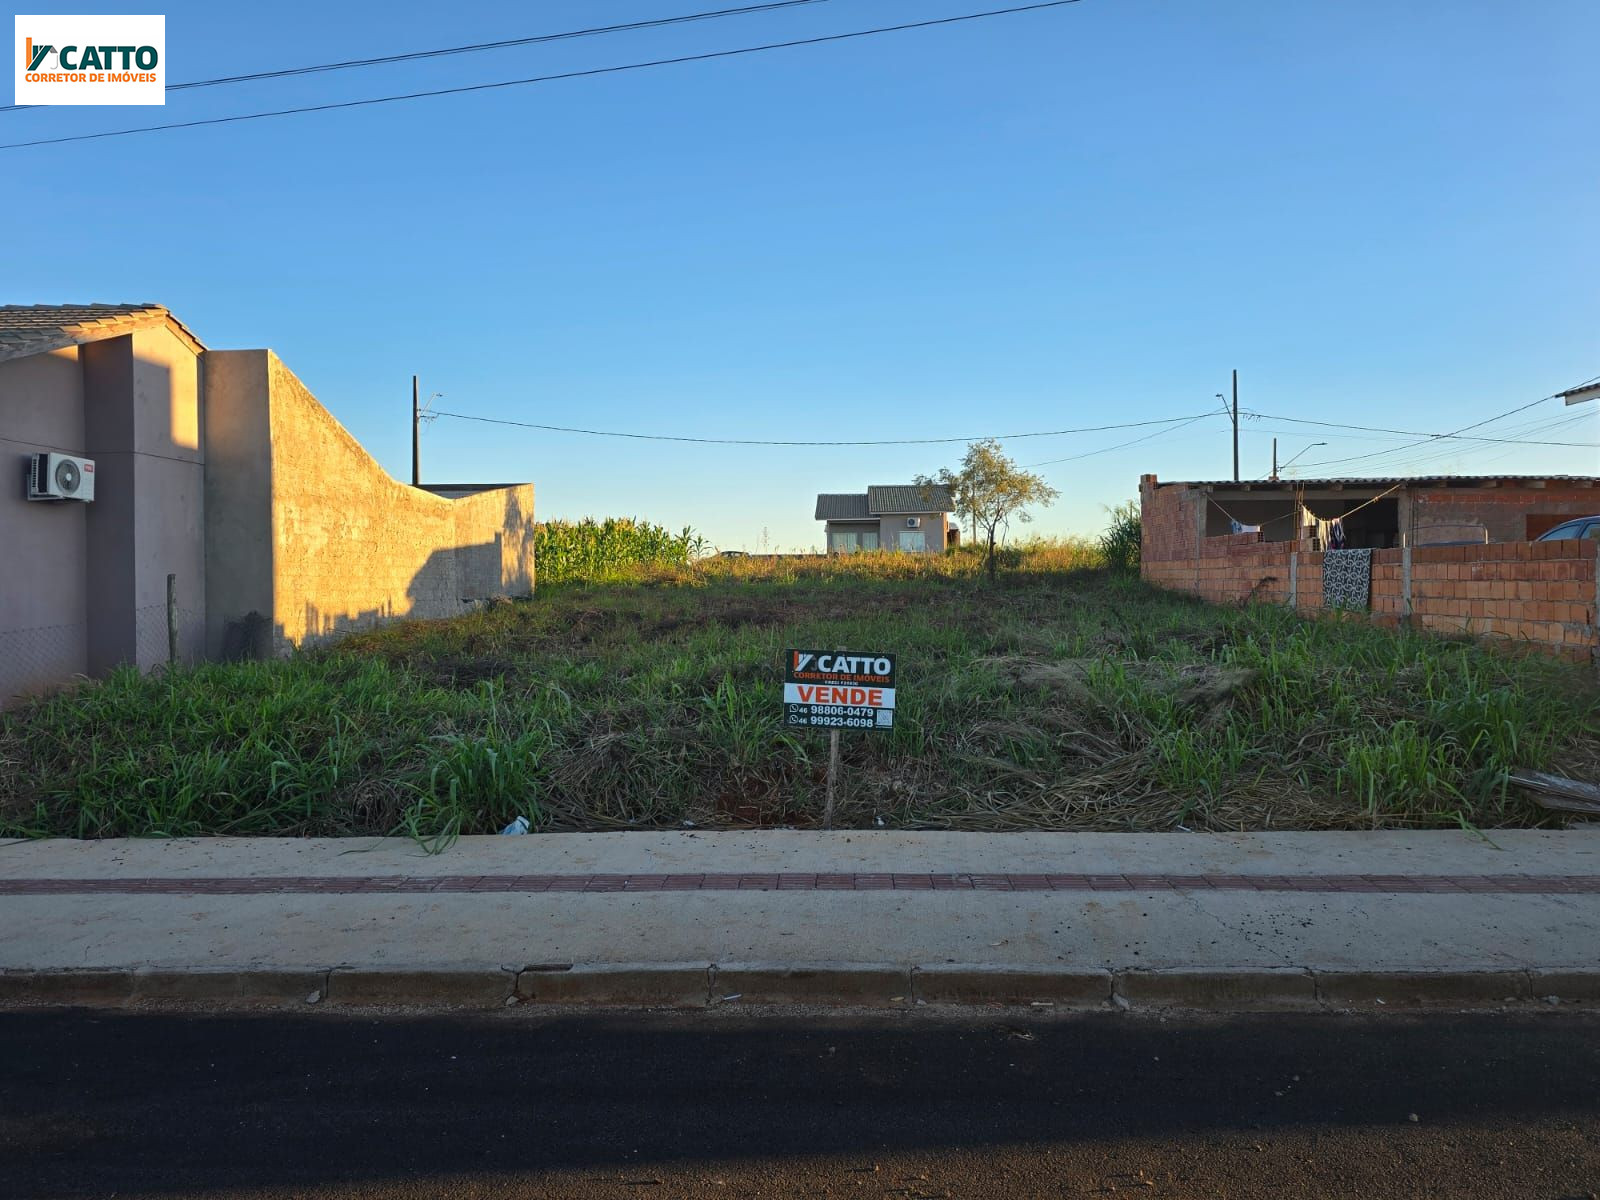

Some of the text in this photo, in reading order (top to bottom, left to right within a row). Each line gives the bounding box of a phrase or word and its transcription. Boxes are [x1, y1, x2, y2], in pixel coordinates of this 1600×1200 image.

[817, 655, 891, 675] CATTO
[794, 671, 839, 681] CORRETOR
[840, 673, 852, 681] DE
[797, 685, 883, 706] VENDE
[811, 705, 874, 717] 98806-0479
[811, 716, 874, 727] 99923-6098
